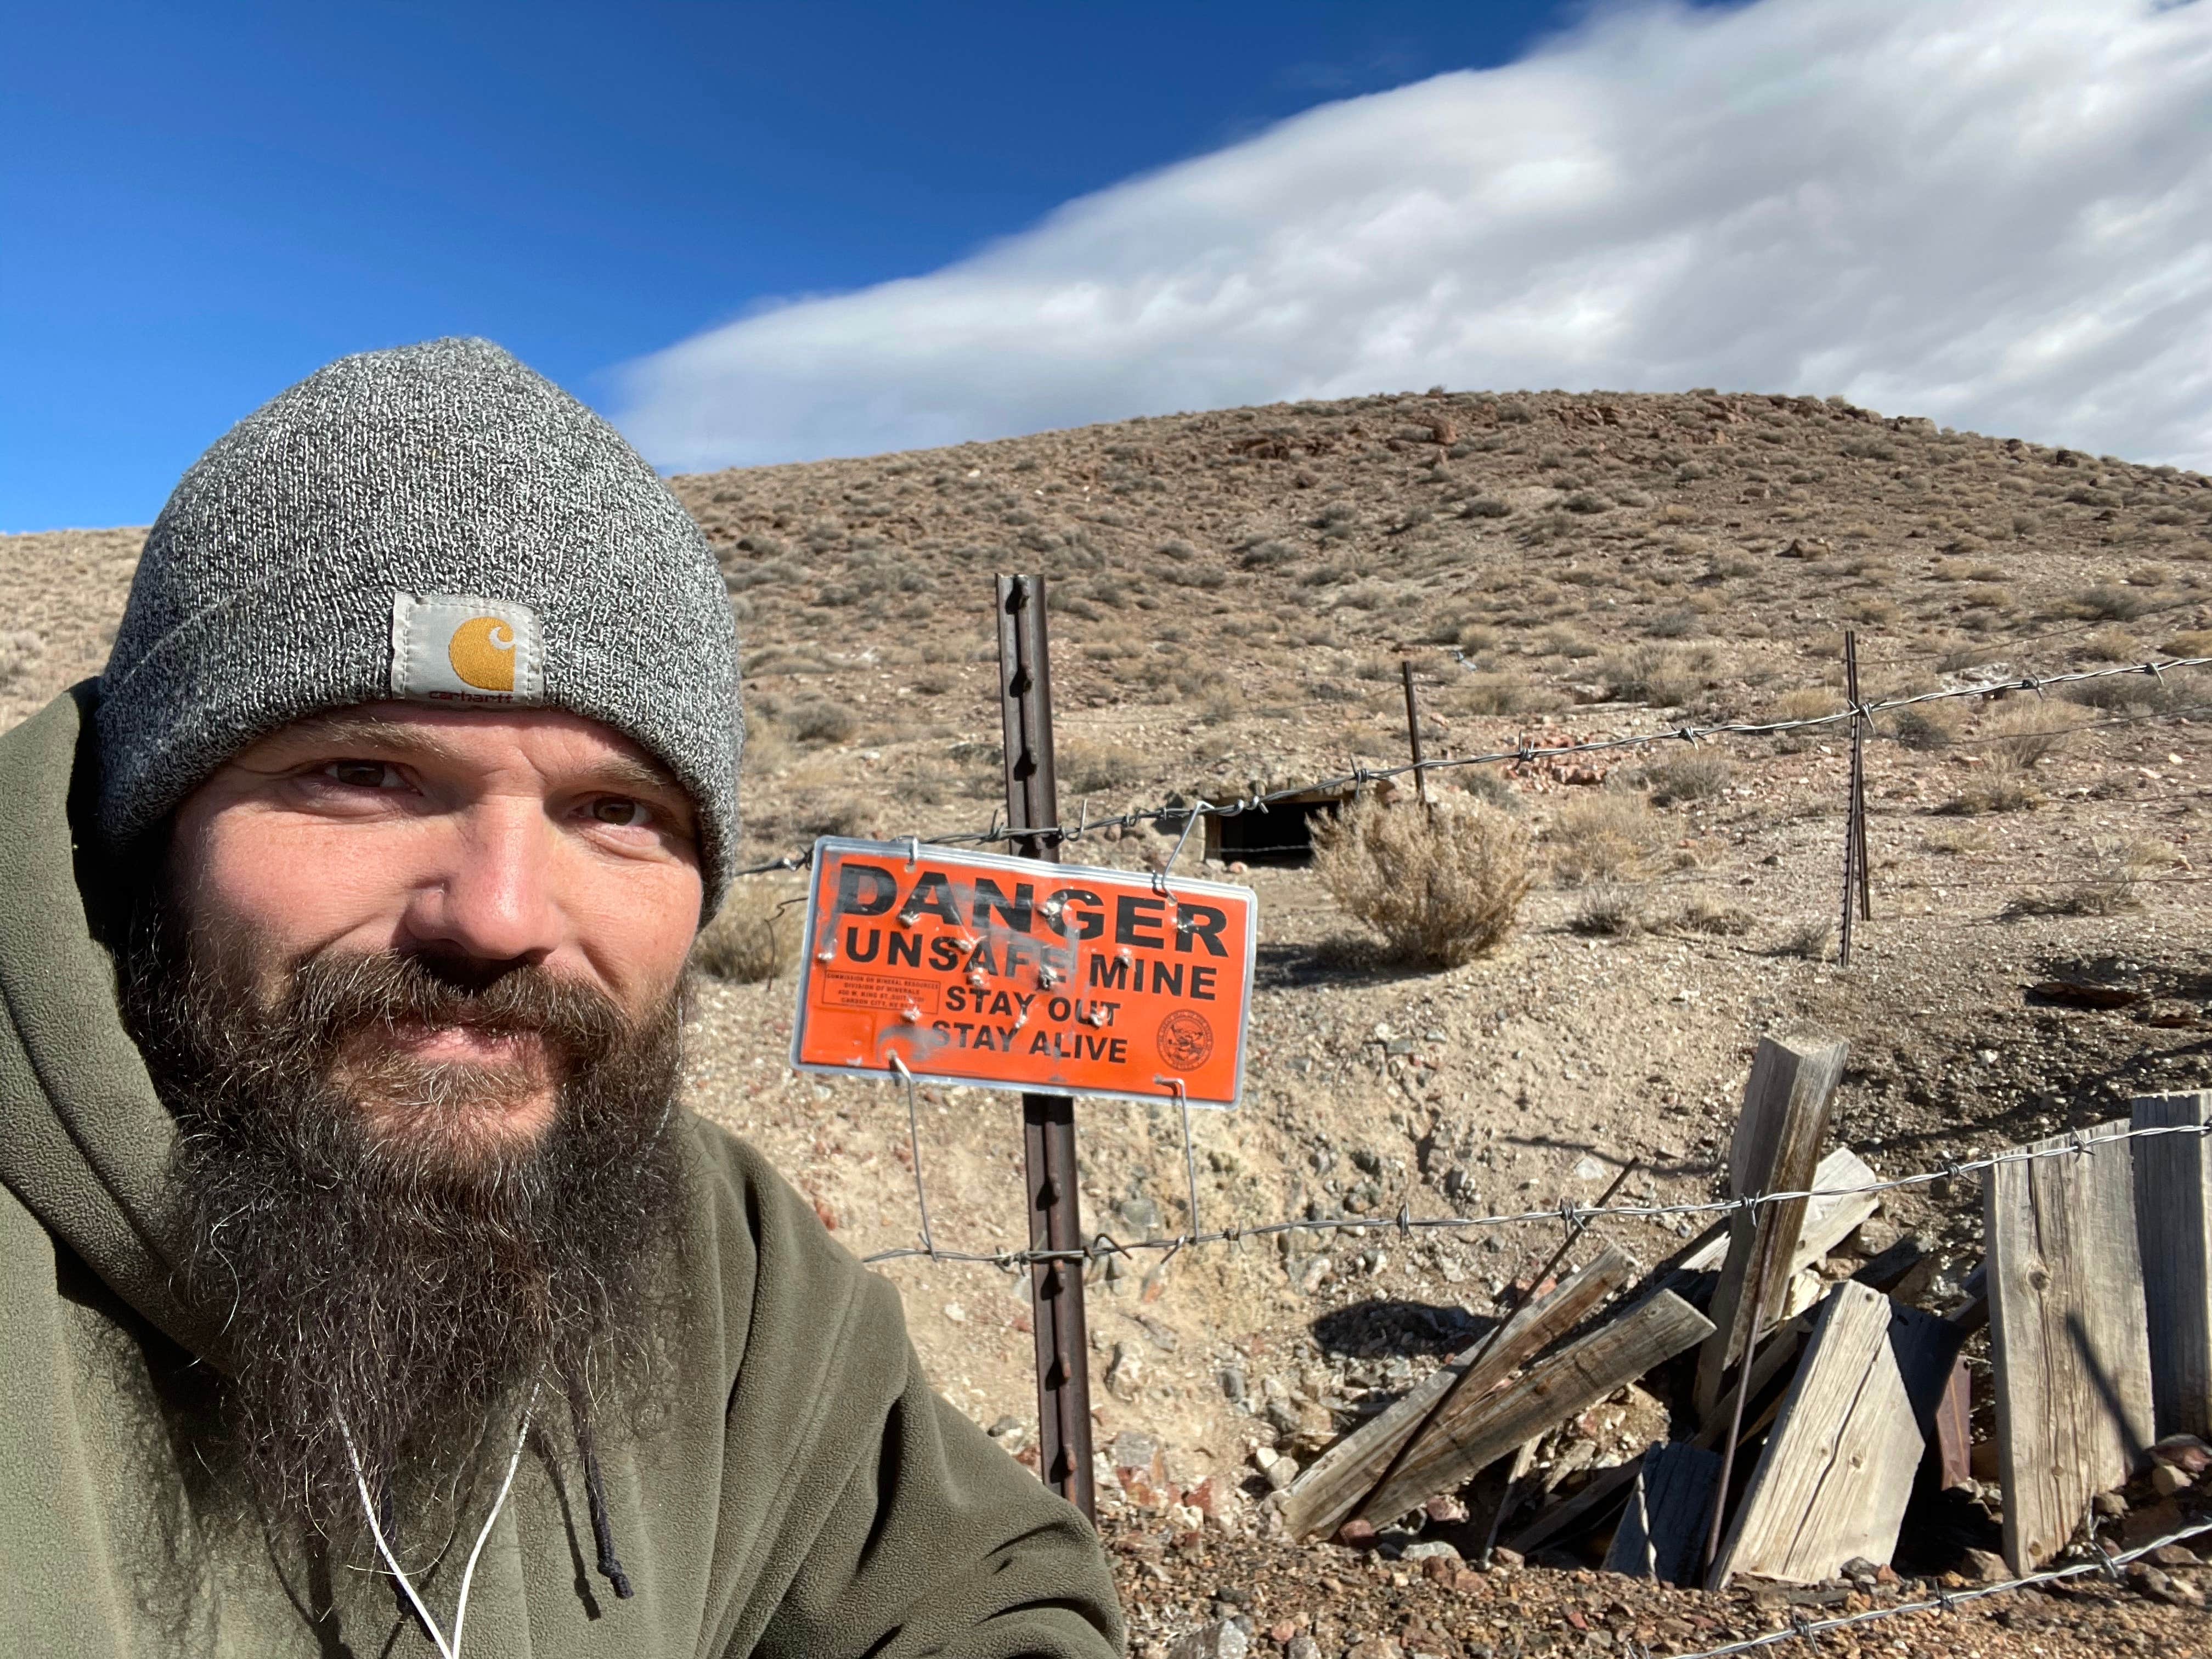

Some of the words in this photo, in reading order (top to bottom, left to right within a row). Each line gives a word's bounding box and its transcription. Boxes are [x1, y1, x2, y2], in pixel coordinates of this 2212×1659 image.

[429, 690, 513, 703] carhartt
[839, 863, 1229, 957] DANGER
[845, 927, 1066, 985] UNSAFE
[1090, 953, 1217, 1000] MINE
[945, 986, 1036, 1019] STAY
[1048, 997, 1121, 1027] OUT
[932, 1020, 1021, 1052] STAY
[1029, 1030, 1128, 1063] ALIVE
